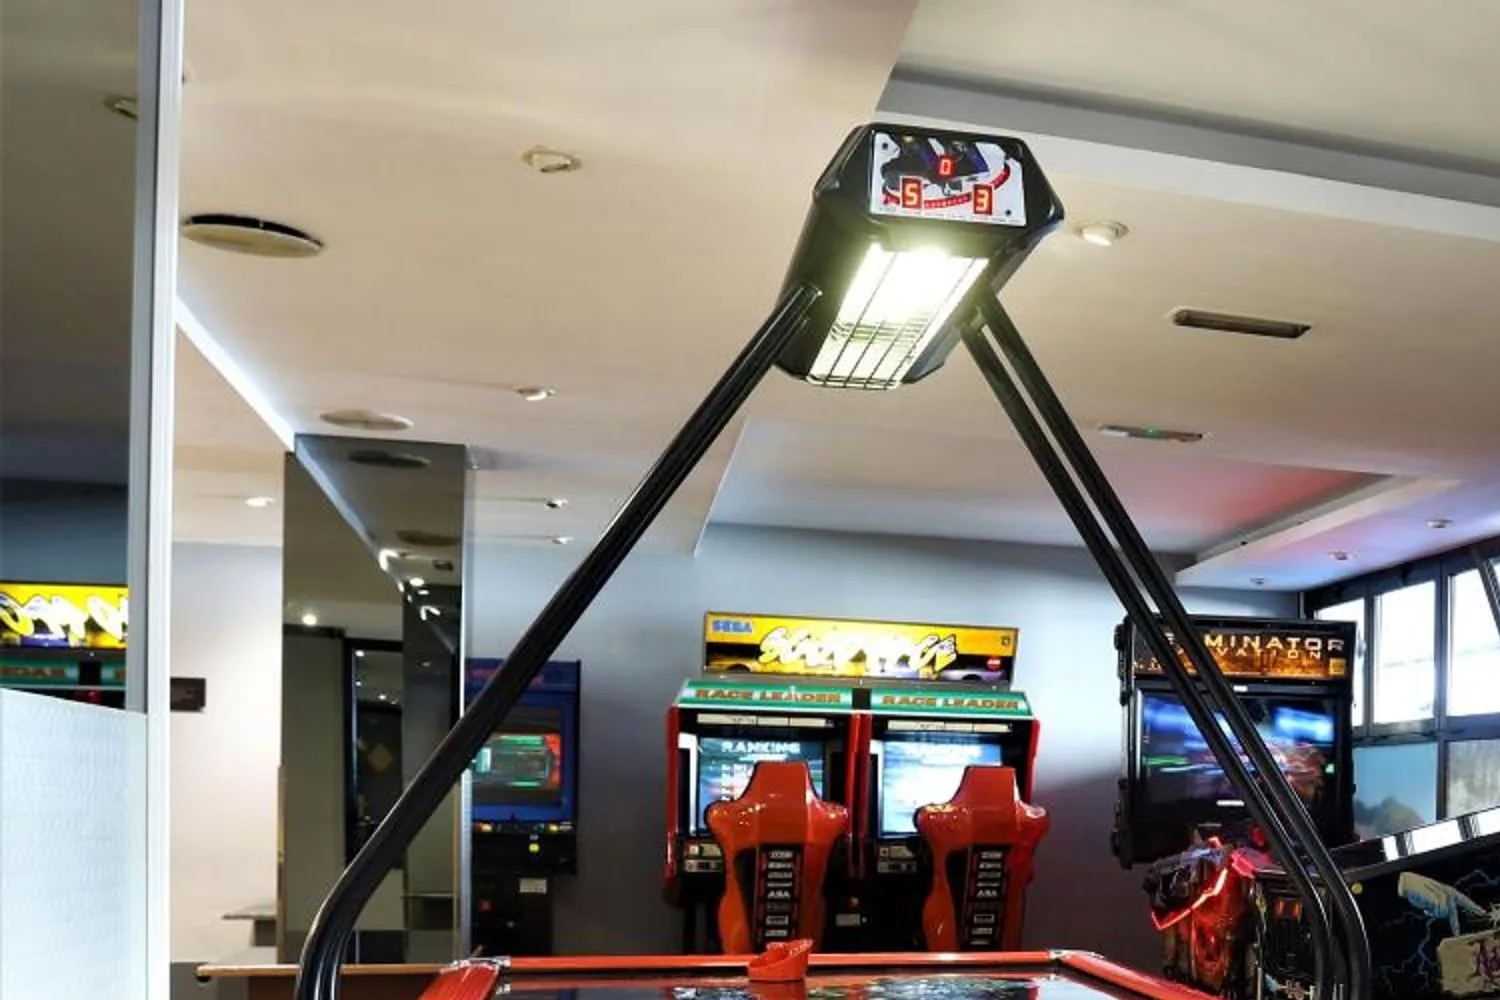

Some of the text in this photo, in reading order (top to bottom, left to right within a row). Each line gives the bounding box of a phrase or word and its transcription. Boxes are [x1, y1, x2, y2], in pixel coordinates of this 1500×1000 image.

[902, 182, 919, 206] 5
[974, 188, 990, 212] 3
[712, 620, 752, 633] SEGA
[696, 689, 841, 703] RACE LEADER
[882, 695, 1018, 709] RACE LEADER
[721, 741, 801, 754] RANKING
